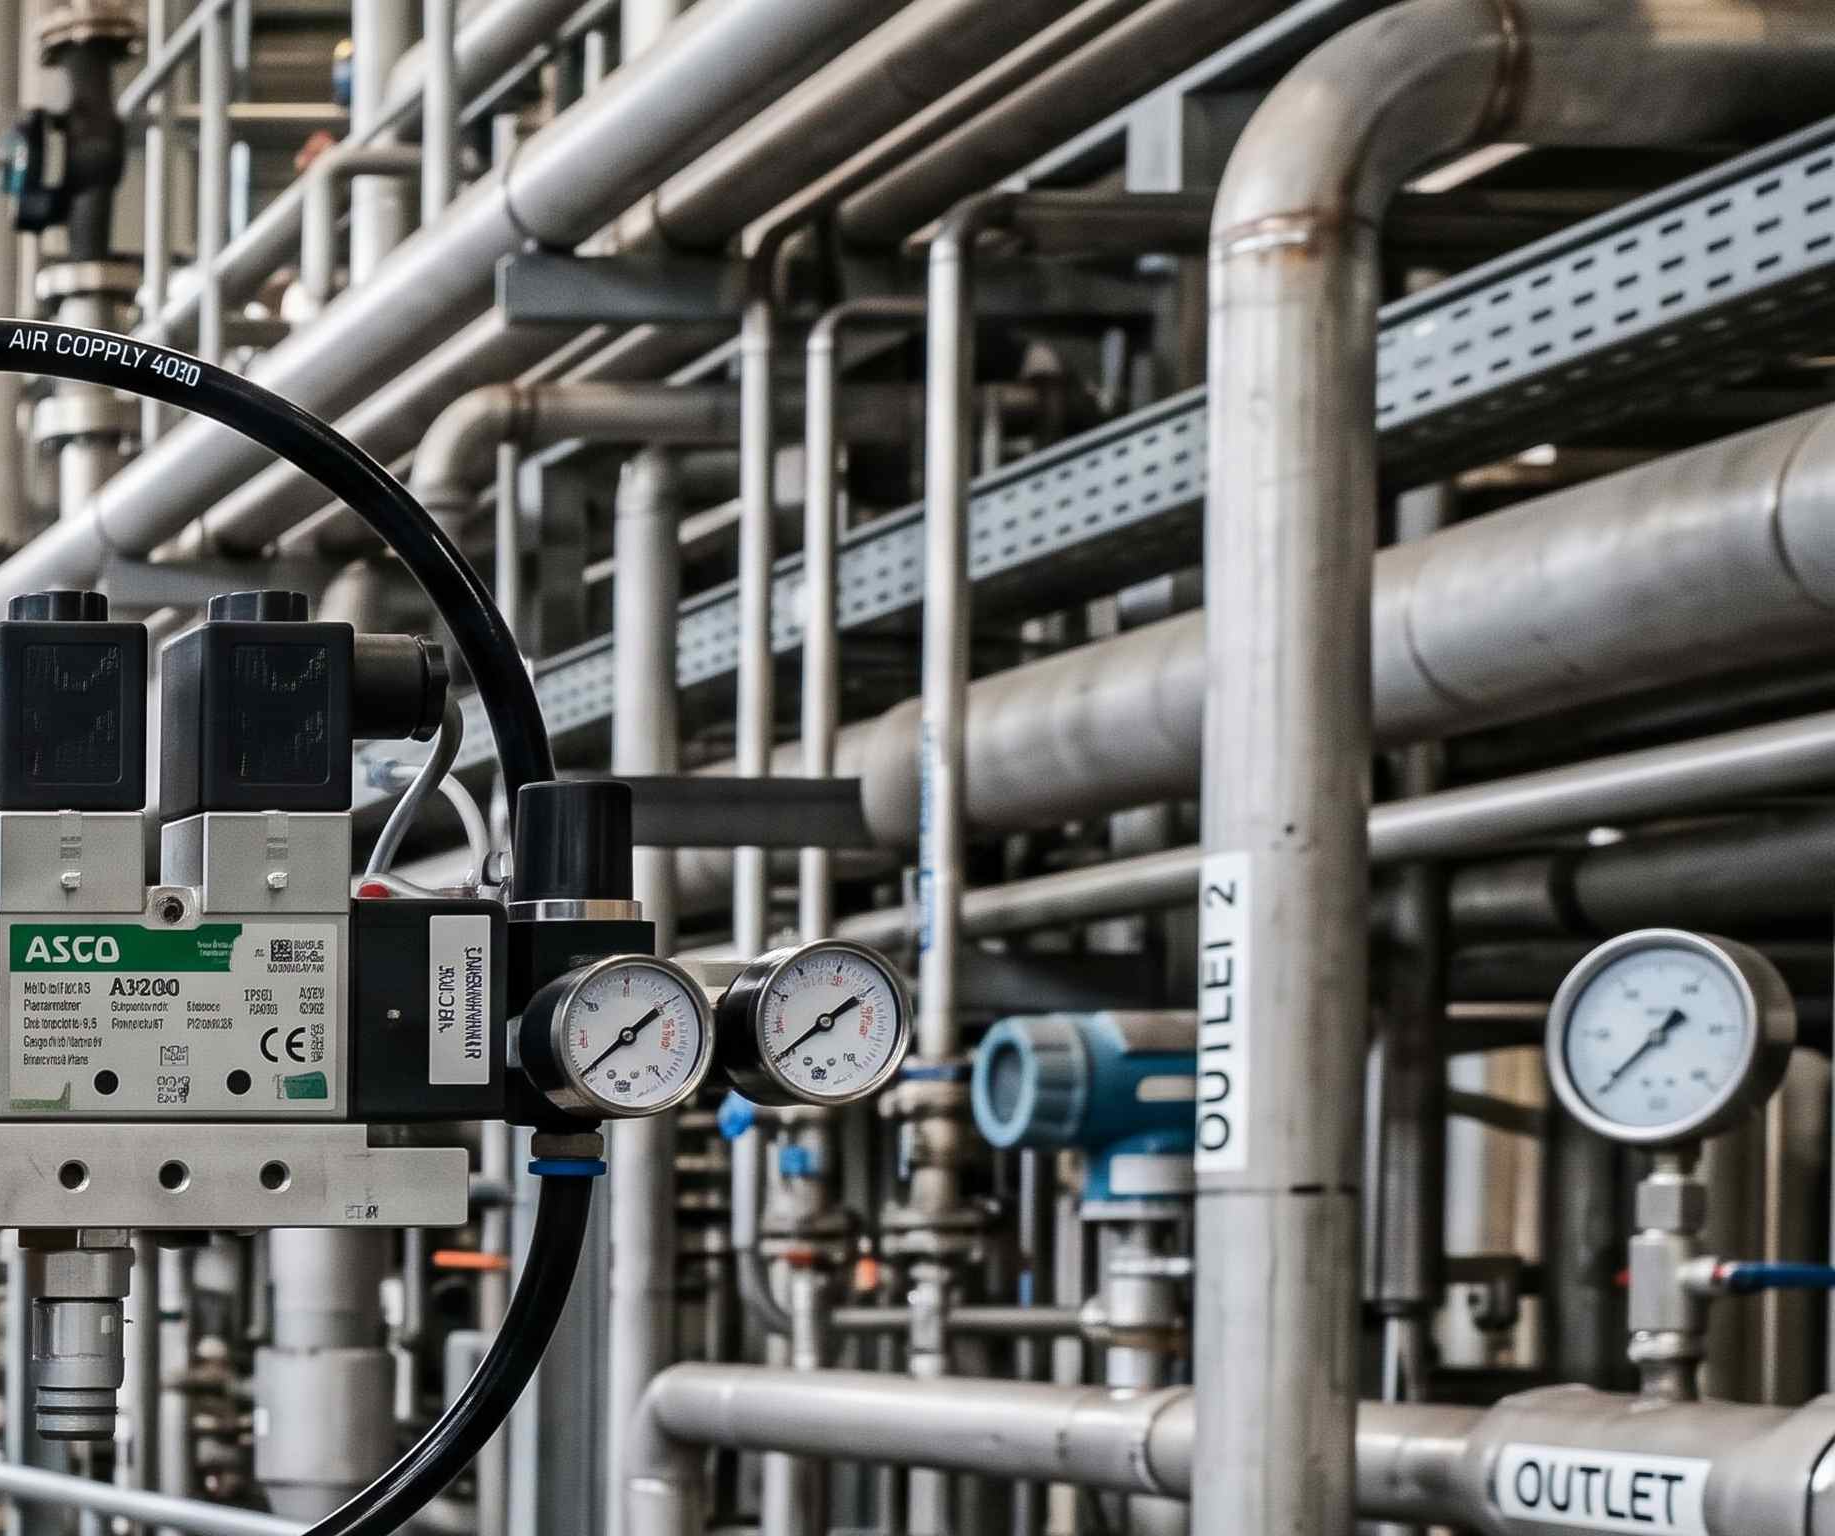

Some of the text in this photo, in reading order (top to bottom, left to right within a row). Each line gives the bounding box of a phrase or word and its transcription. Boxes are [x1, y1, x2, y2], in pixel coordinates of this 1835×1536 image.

[8, 328, 49, 352] AIR
[55, 333, 147, 369] COPPLY
[1205, 880, 1235, 906] 2
[24, 936, 121, 964] ASCO
[1516, 1460, 1685, 1525] OUTLET
